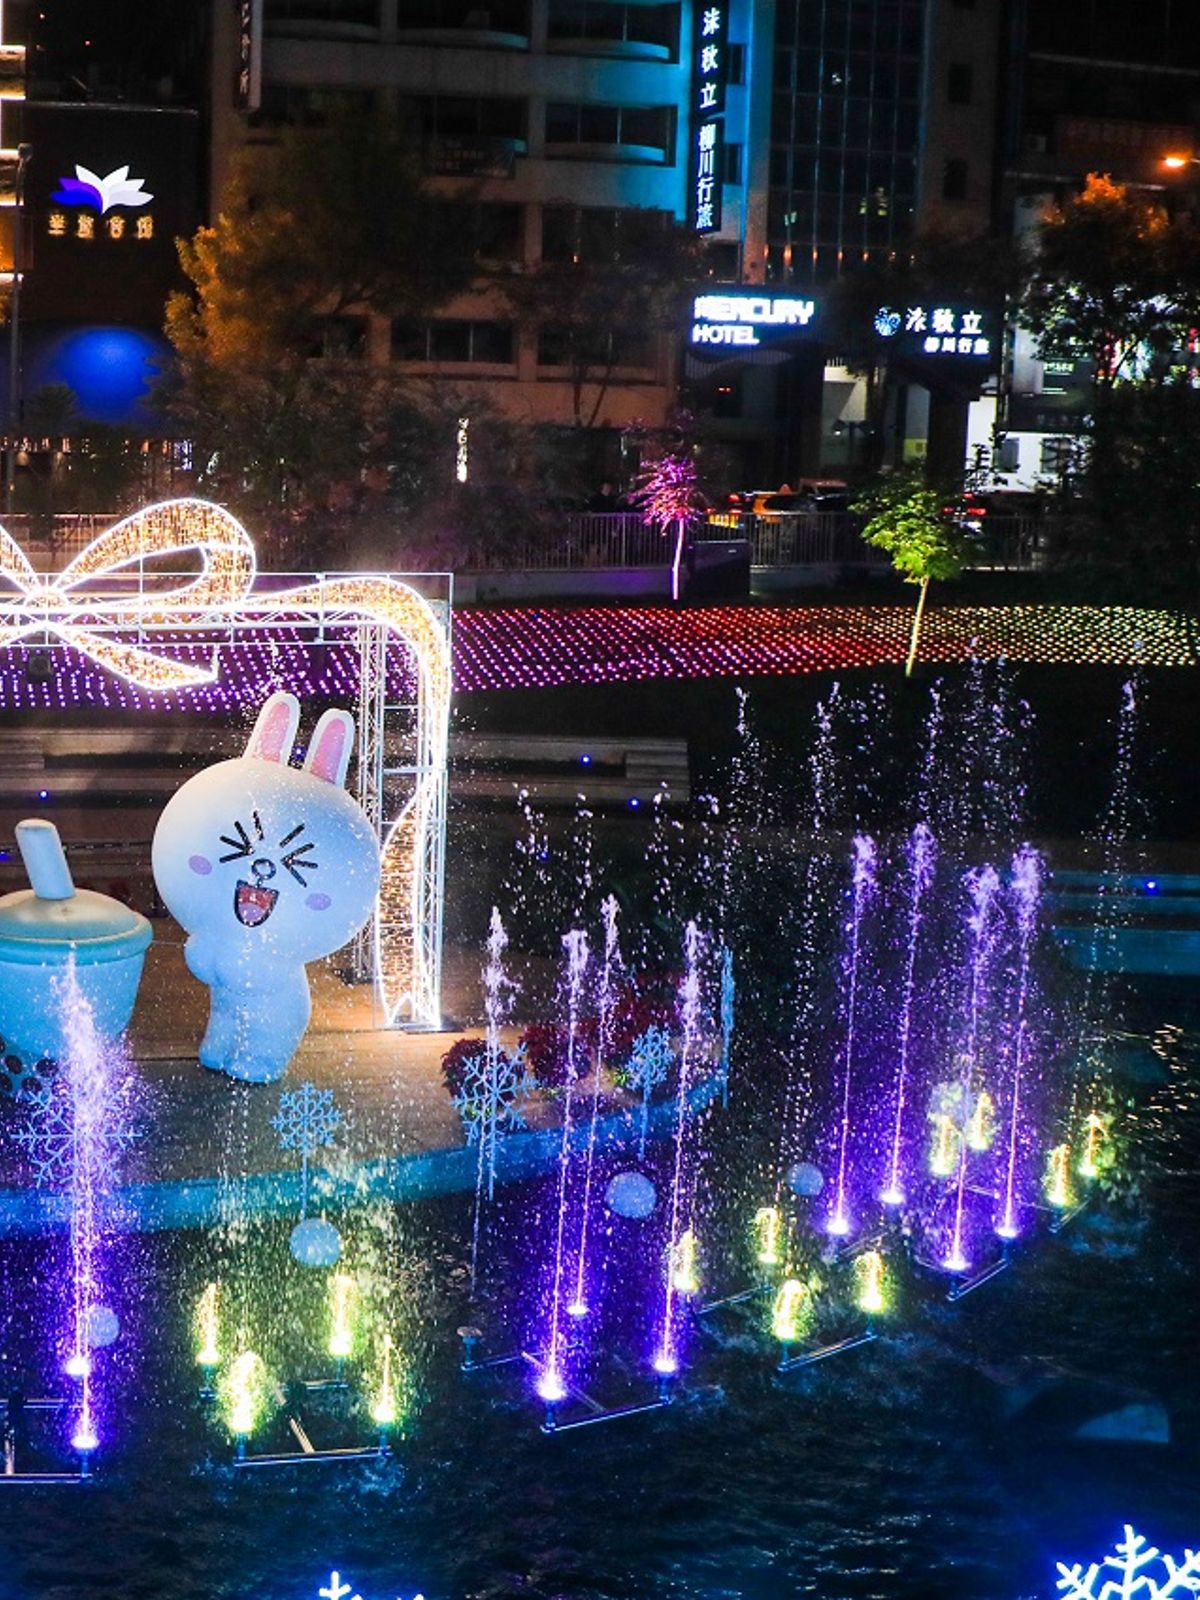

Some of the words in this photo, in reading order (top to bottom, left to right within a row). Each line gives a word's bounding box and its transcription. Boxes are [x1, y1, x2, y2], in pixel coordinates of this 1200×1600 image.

[696, 123, 717, 230] 柳川行旅
[693, 295, 815, 325] MERCURY
[691, 323, 761, 345] HOTEL
